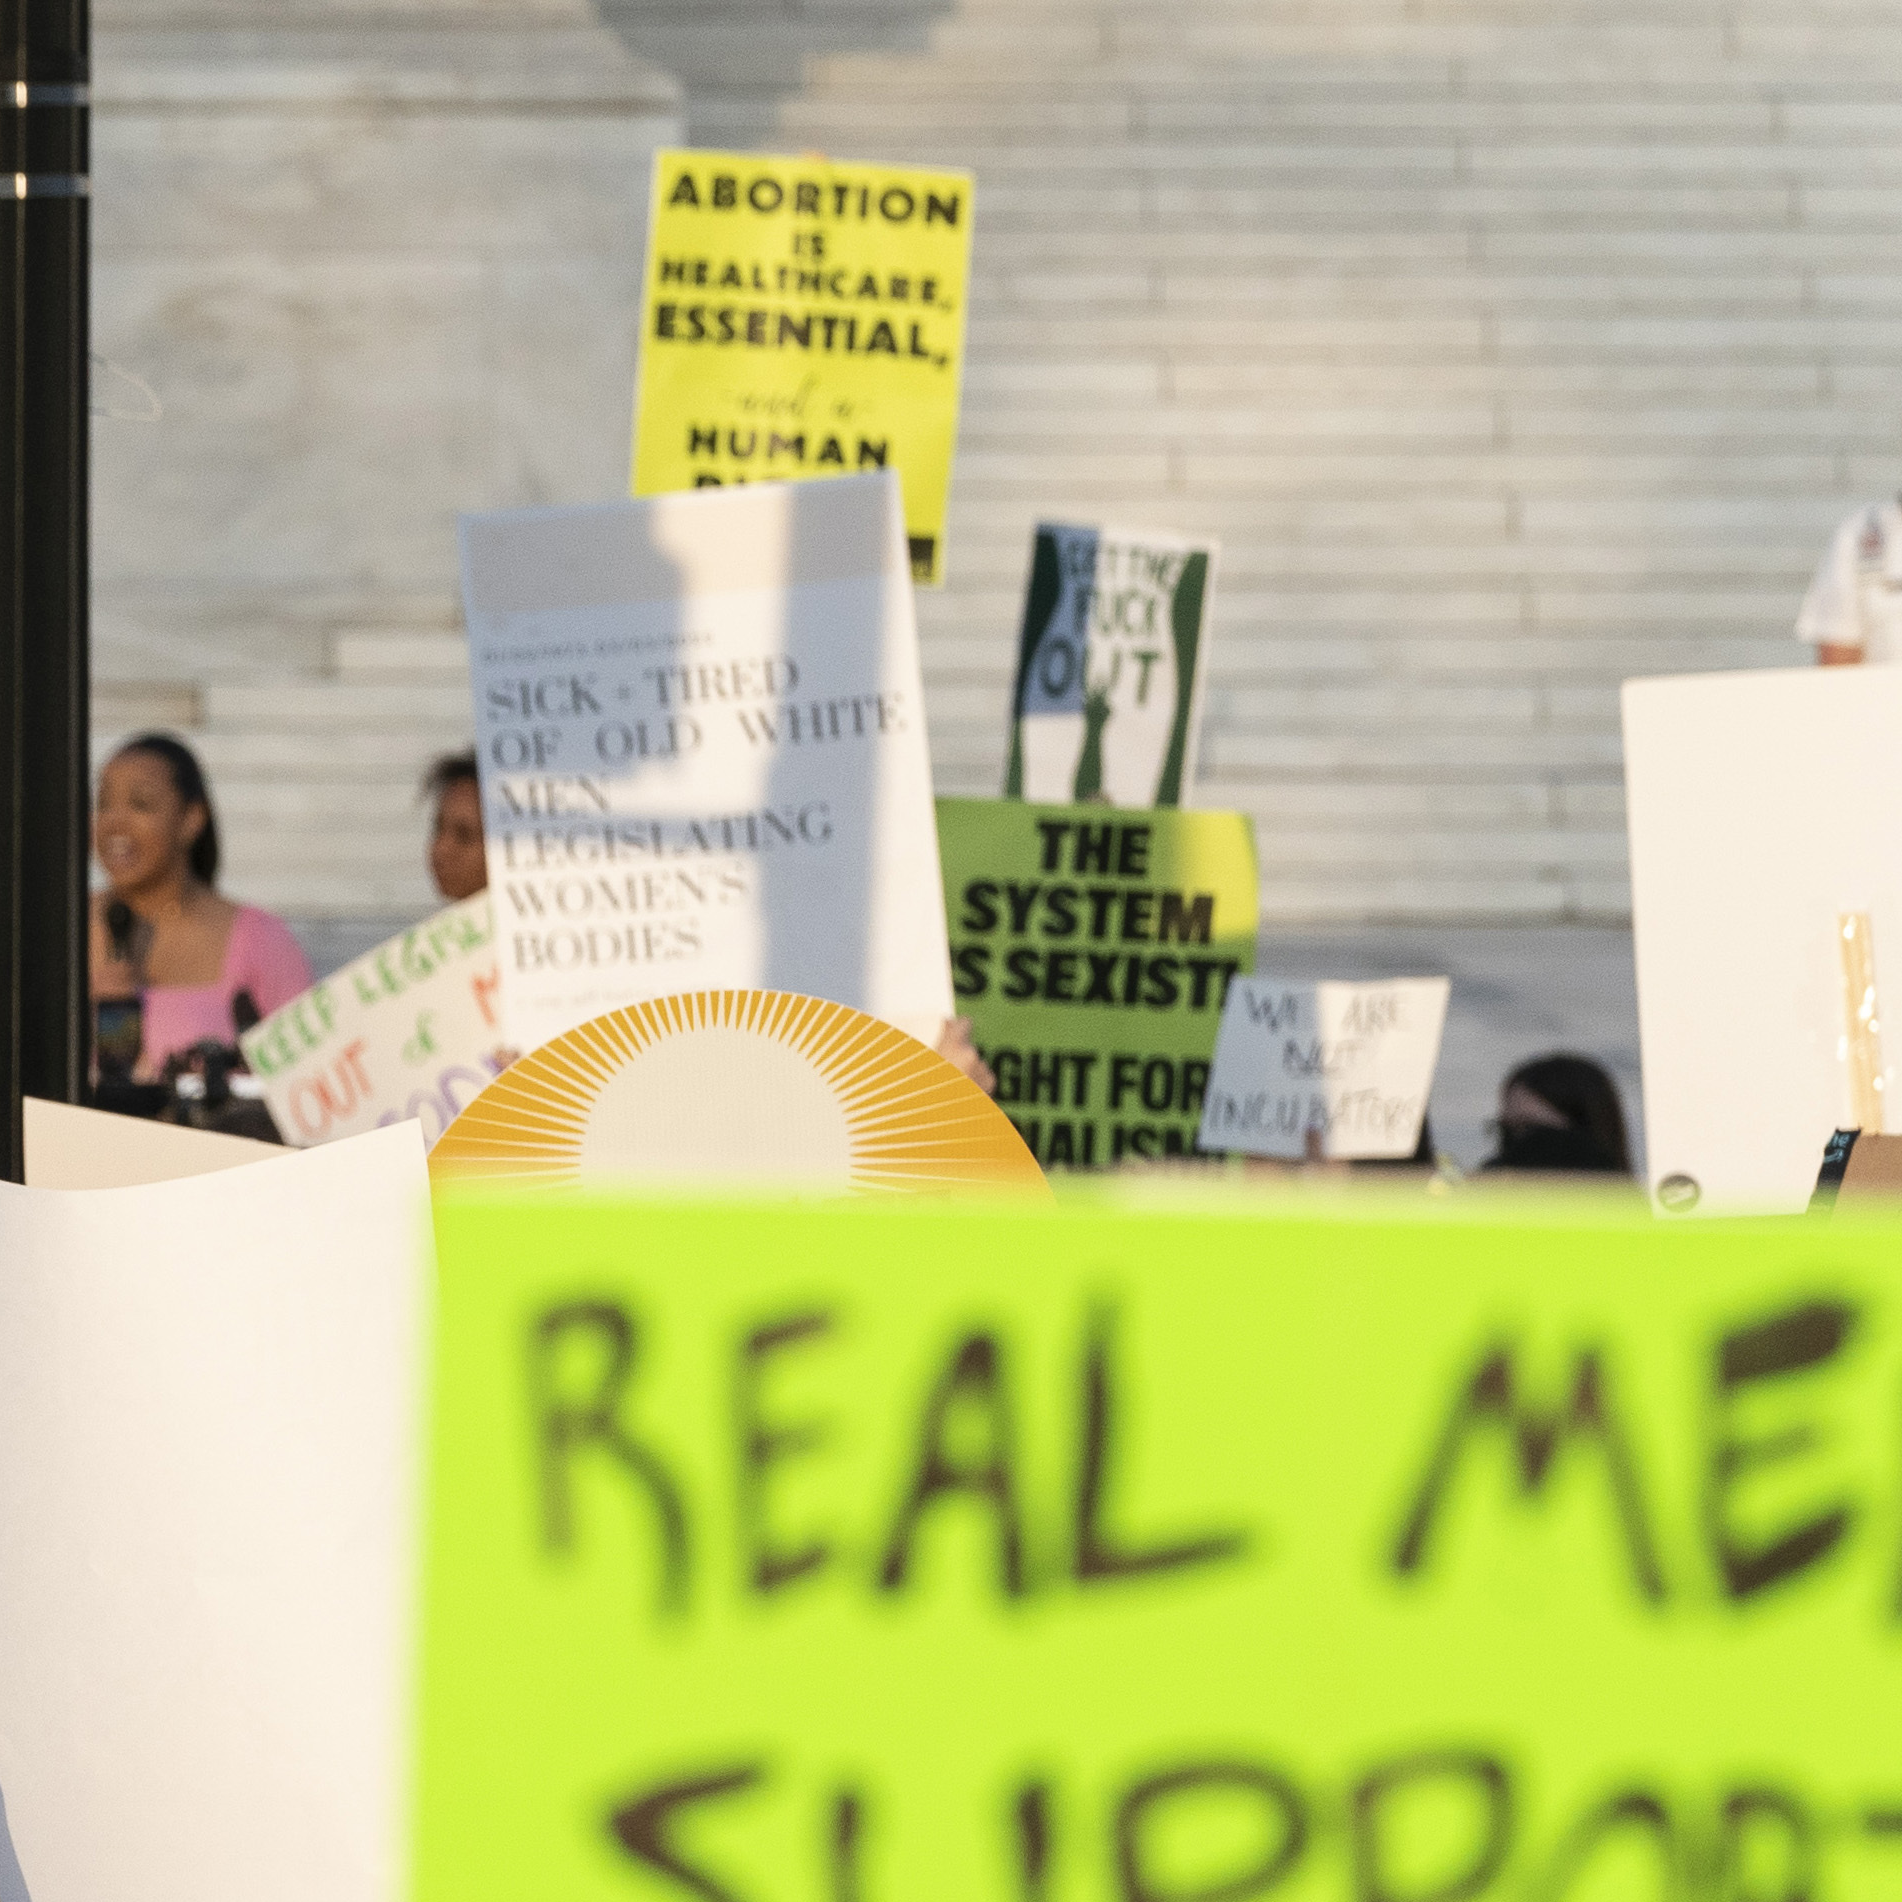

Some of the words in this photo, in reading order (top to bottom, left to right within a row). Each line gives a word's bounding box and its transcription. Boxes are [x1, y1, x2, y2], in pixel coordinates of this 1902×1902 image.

[669, 172, 961, 227] ABORTION
[794, 231, 826, 259] IS
[654, 304, 950, 368] ESSENTIAL,
[687, 426, 889, 470] HUMAN
[486, 670, 599, 724] SICK
[643, 654, 800, 715] TIRED
[1040, 636, 1161, 709] OUT
[491, 726, 563, 771] OF
[595, 716, 704, 765] OLD
[738, 691, 909, 746] WHITE
[499, 774, 610, 821] MEN
[501, 802, 835, 871] LEGISLATING
[1037, 820, 1152, 877] THE
[961, 880, 1216, 946] SYSTEM
[513, 921, 703, 973] BODIES
[252, 985, 337, 1079] KEEP
[288, 1037, 374, 1140] OUT
[990, 1049, 1097, 1108] GHT
[522, 1285, 1255, 1632] REAL
[1384, 1290, 1902, 1608] ME
